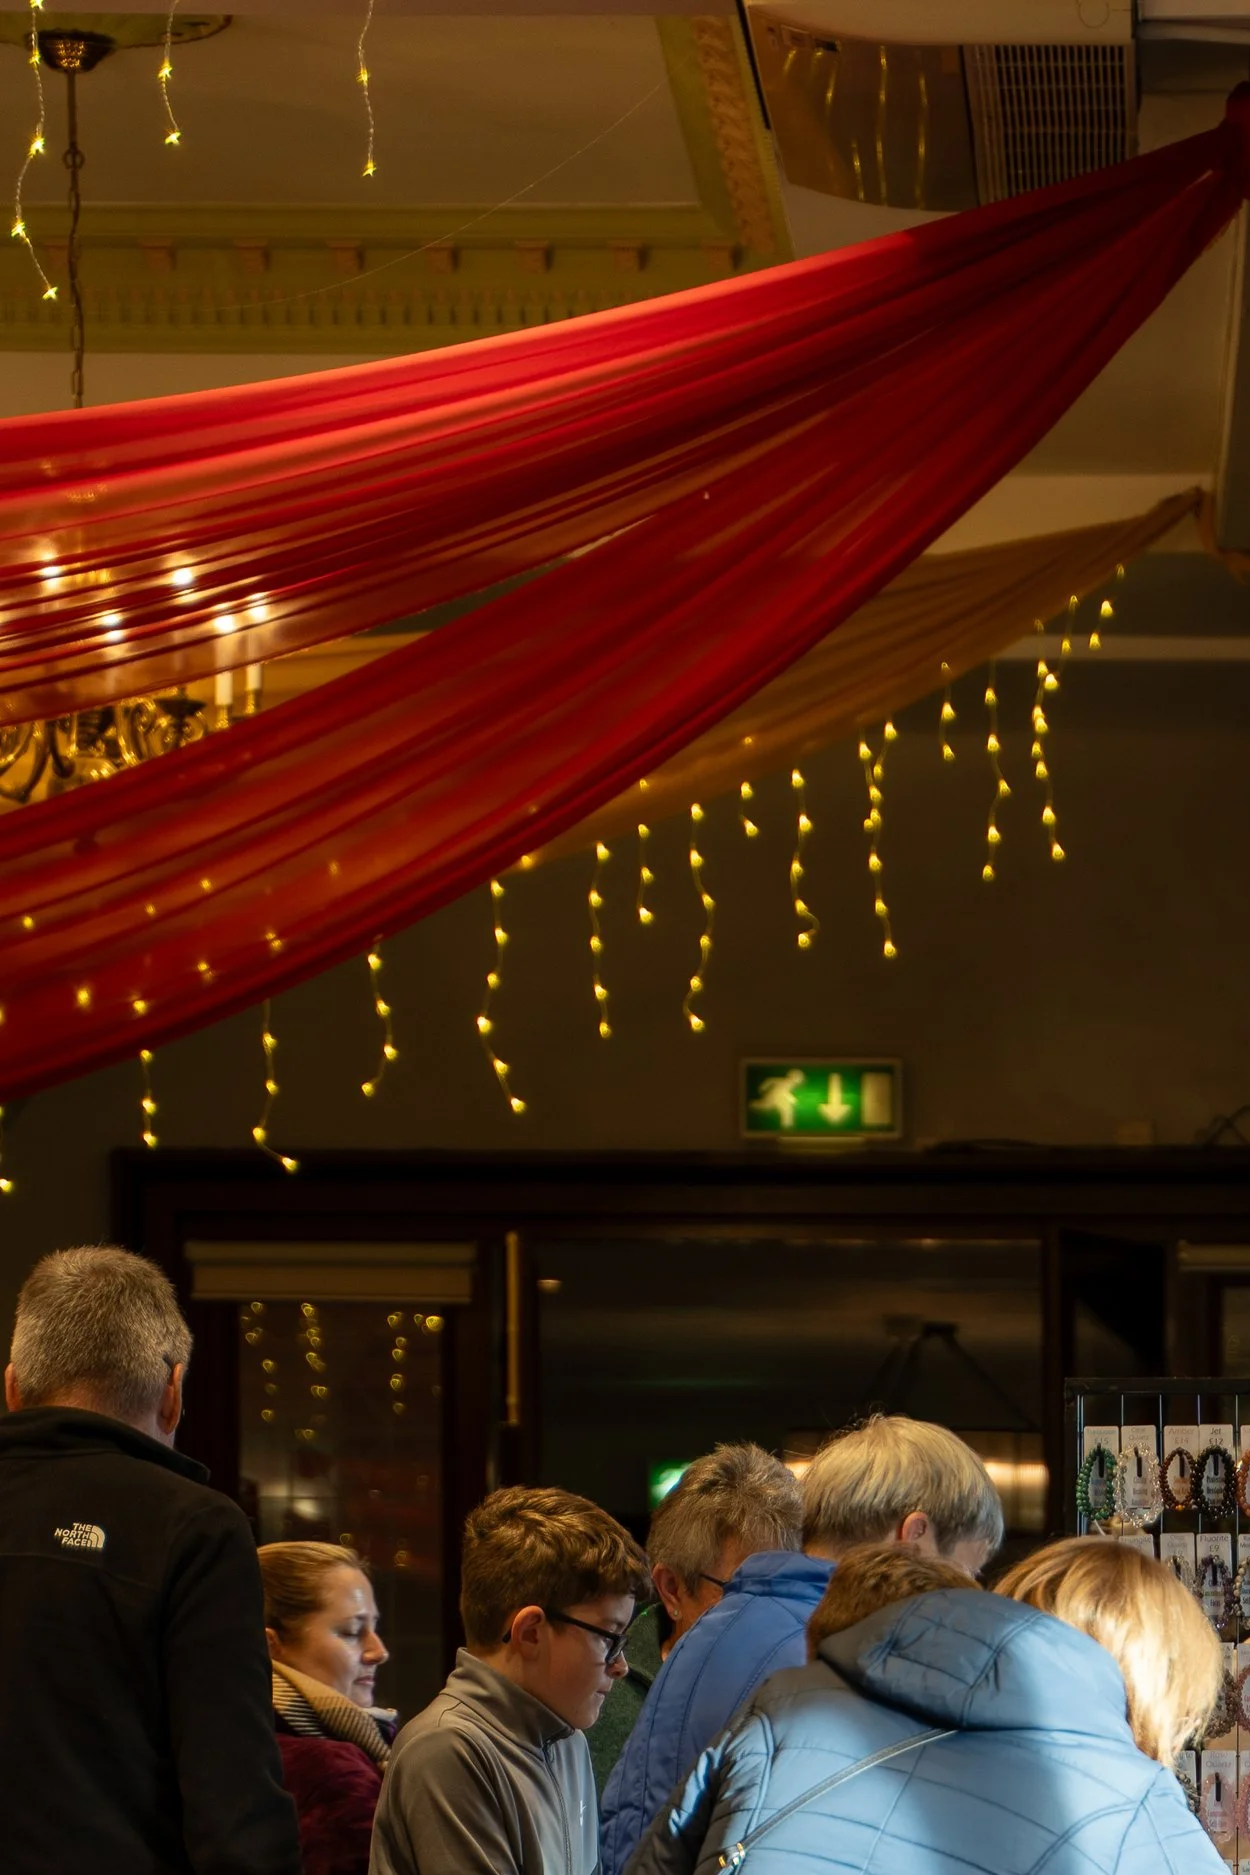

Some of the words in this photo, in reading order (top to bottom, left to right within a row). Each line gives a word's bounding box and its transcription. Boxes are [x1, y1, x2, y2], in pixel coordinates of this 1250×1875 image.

[72, 1522, 93, 1532] THE
[54, 1527, 91, 1539] NORTH
[61, 1537, 88, 1547] FACE
